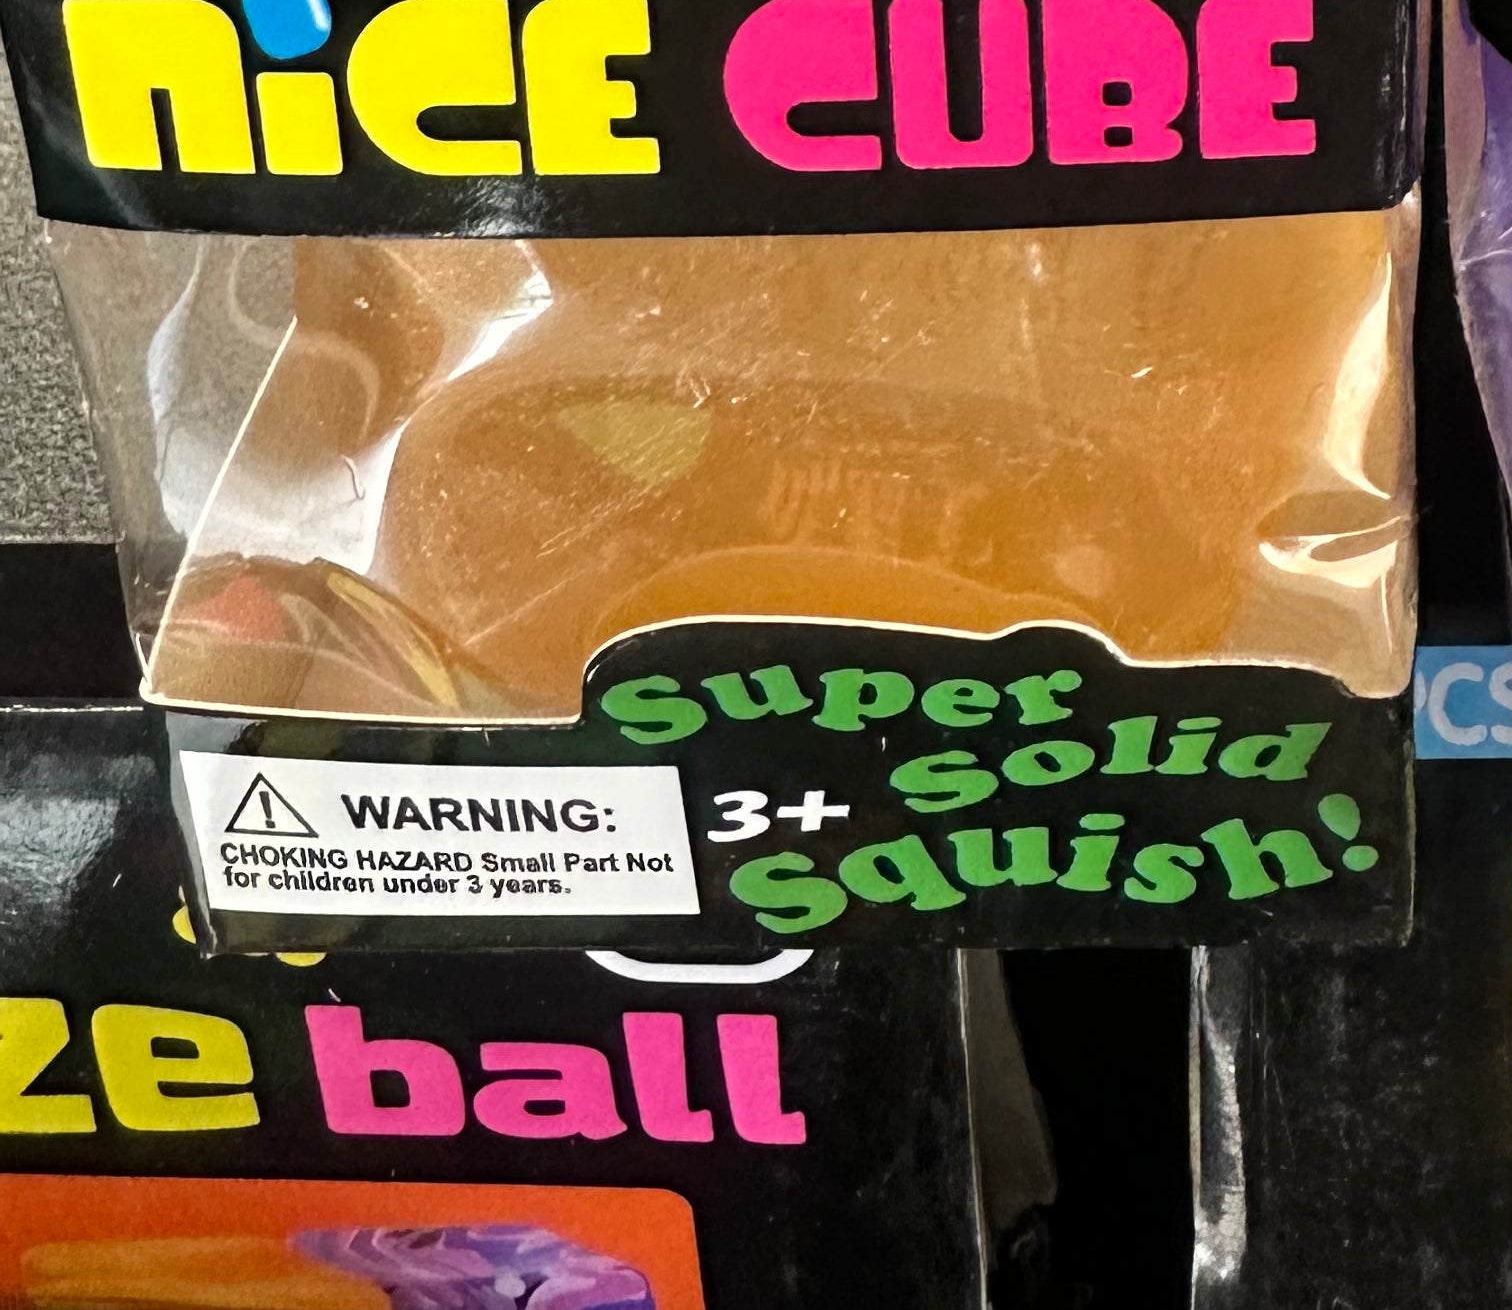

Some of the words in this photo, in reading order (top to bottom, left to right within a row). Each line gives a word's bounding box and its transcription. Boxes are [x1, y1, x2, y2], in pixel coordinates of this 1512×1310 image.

[597, 664, 1083, 746] Super
[341, 793, 617, 833] WARNING:
[708, 790, 851, 843] 3+
[221, 842, 349, 870] CHOKING
[356, 849, 473, 872] HAZARD
[482, 851, 555, 872] Small
[564, 852, 620, 872] Part
[627, 852, 674, 873] Not
[224, 866, 261, 890] for
[268, 869, 375, 893] children
[384, 872, 460, 894] under
[468, 874, 483, 893] 3
[492, 877, 572, 898] years.
[732, 794, 1379, 935] Squish!
[306, 1004, 807, 1145] ball
